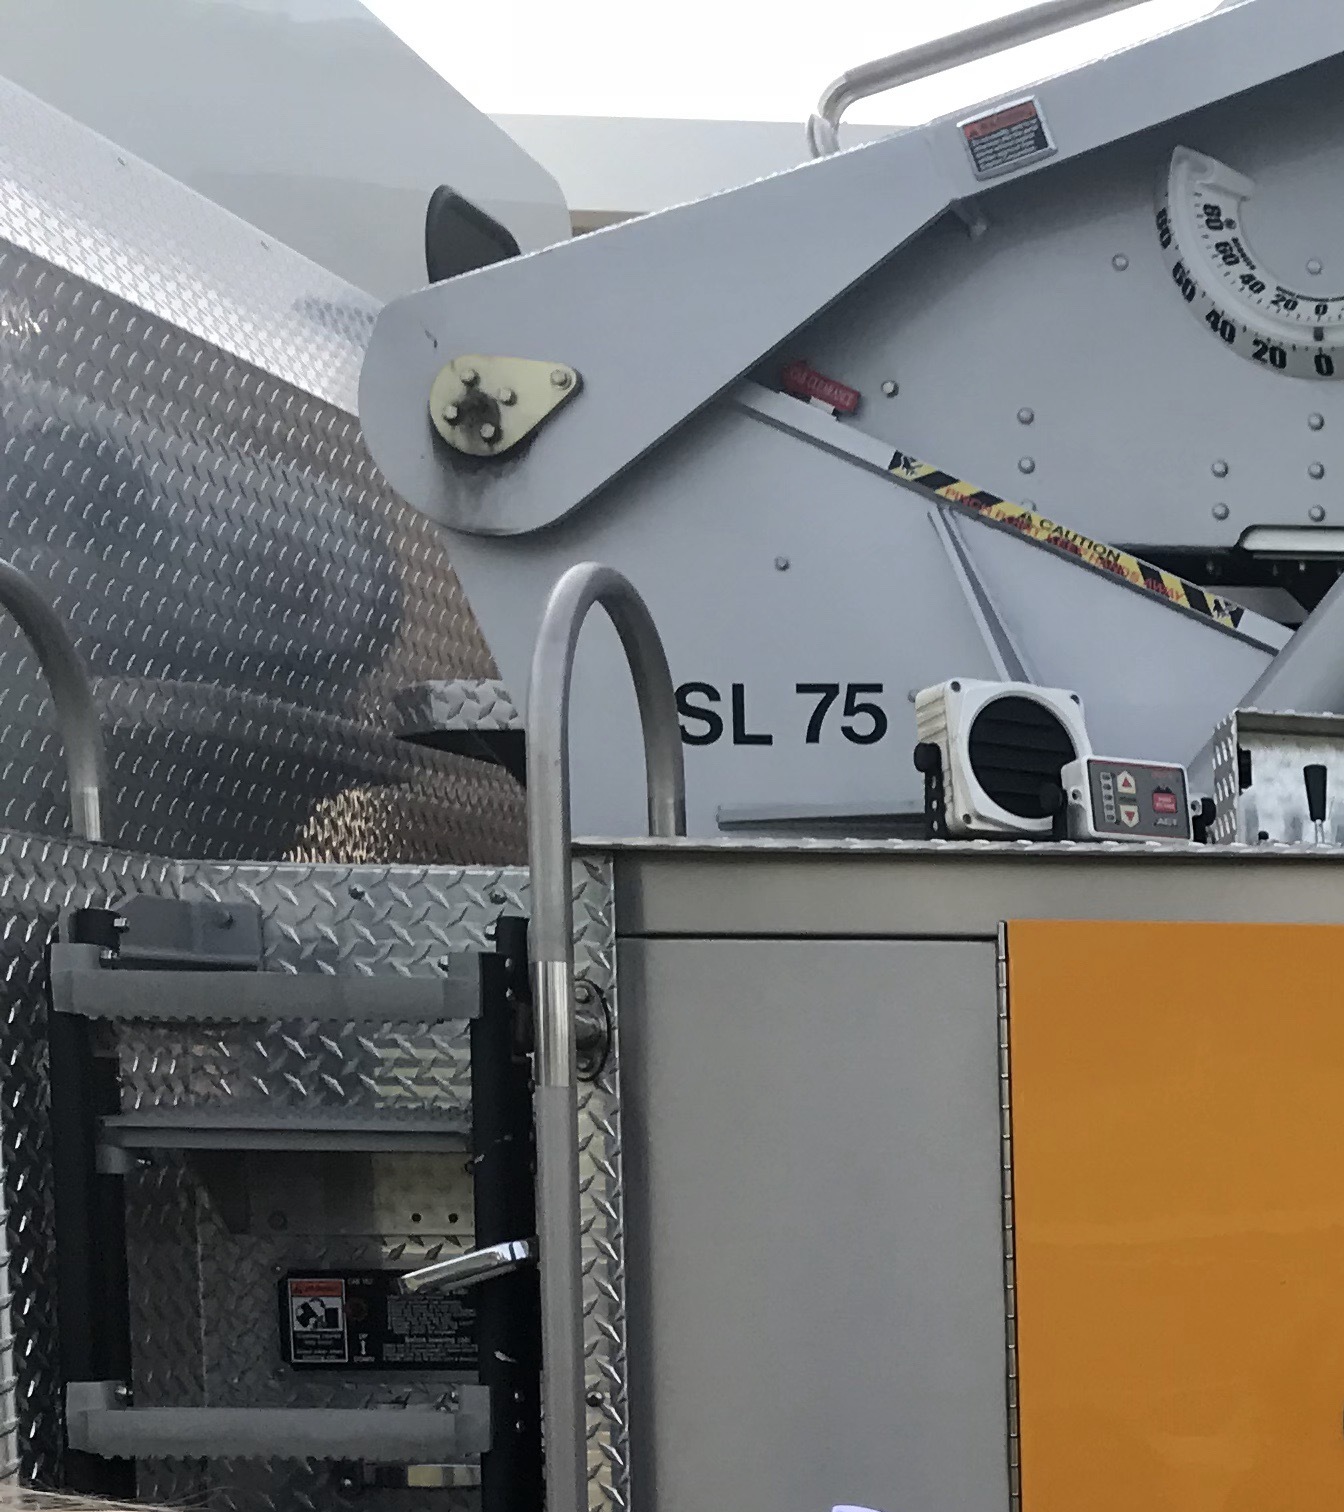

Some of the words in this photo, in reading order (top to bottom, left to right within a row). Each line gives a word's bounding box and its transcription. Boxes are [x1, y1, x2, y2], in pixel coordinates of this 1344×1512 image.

[1214, 241, 1240, 267] 60
[1239, 273, 1266, 294] 40
[1271, 294, 1299, 312] 20
[1314, 303, 1328, 316] 0
[1205, 308, 1236, 345] 40
[1252, 338, 1287, 370] 20
[1314, 353, 1334, 377] 0
[1040, 518, 1121, 563] CAUTION
[673, 682, 774, 747] SL
[795, 682, 889, 746] 75
